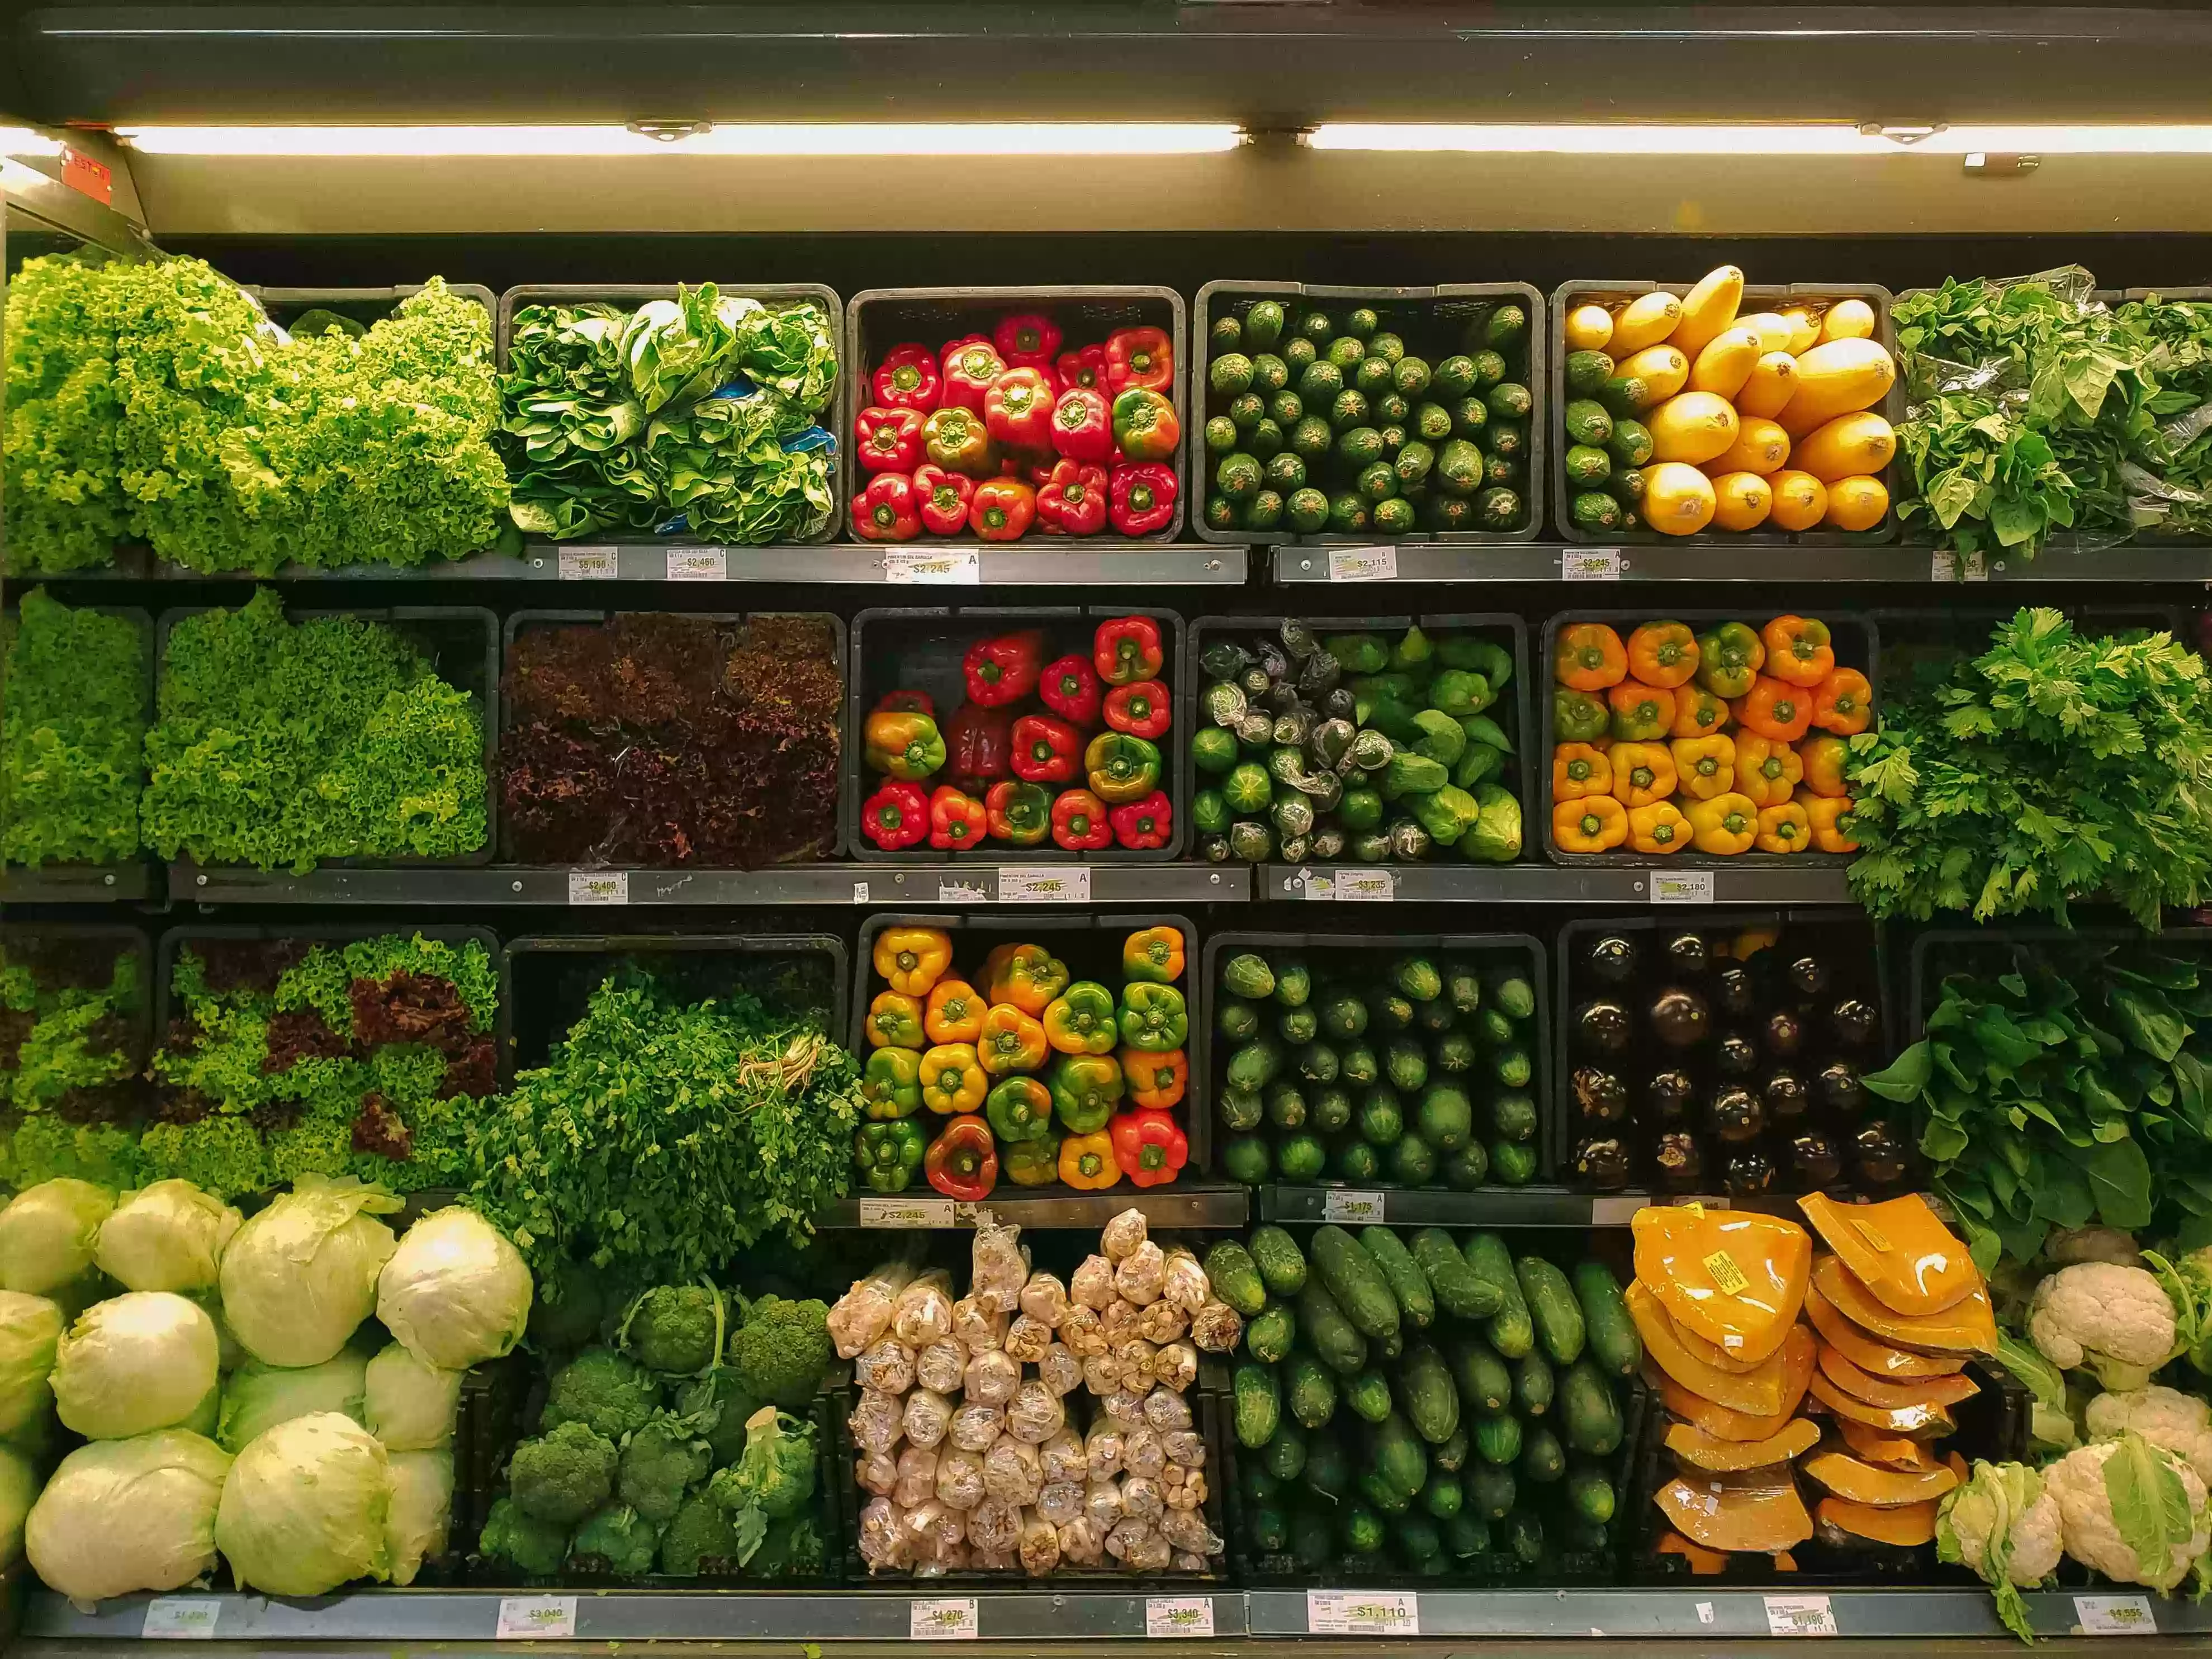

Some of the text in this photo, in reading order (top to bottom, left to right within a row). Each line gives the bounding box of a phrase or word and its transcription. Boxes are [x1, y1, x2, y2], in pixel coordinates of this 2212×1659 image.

[687, 558, 715, 567] $2,460
[969, 555, 977, 565] A
[1583, 558, 1610, 567] $2,245
[579, 560, 606, 570] $5,190
[1079, 873, 1087, 882] A
[589, 881, 616, 890] $2,460
[1025, 883, 1061, 892] $2,245
[1358, 880, 1386, 889] $3,235
[1377, 1194, 1382, 1202] A
[889, 1211, 926, 1220] $2,245
[969, 1599, 974, 1609] B
[1204, 1598, 1210, 1608] A
[1168, 1609, 1198, 1619] $3,340
[1357, 1607, 1406, 1618] $1,110
